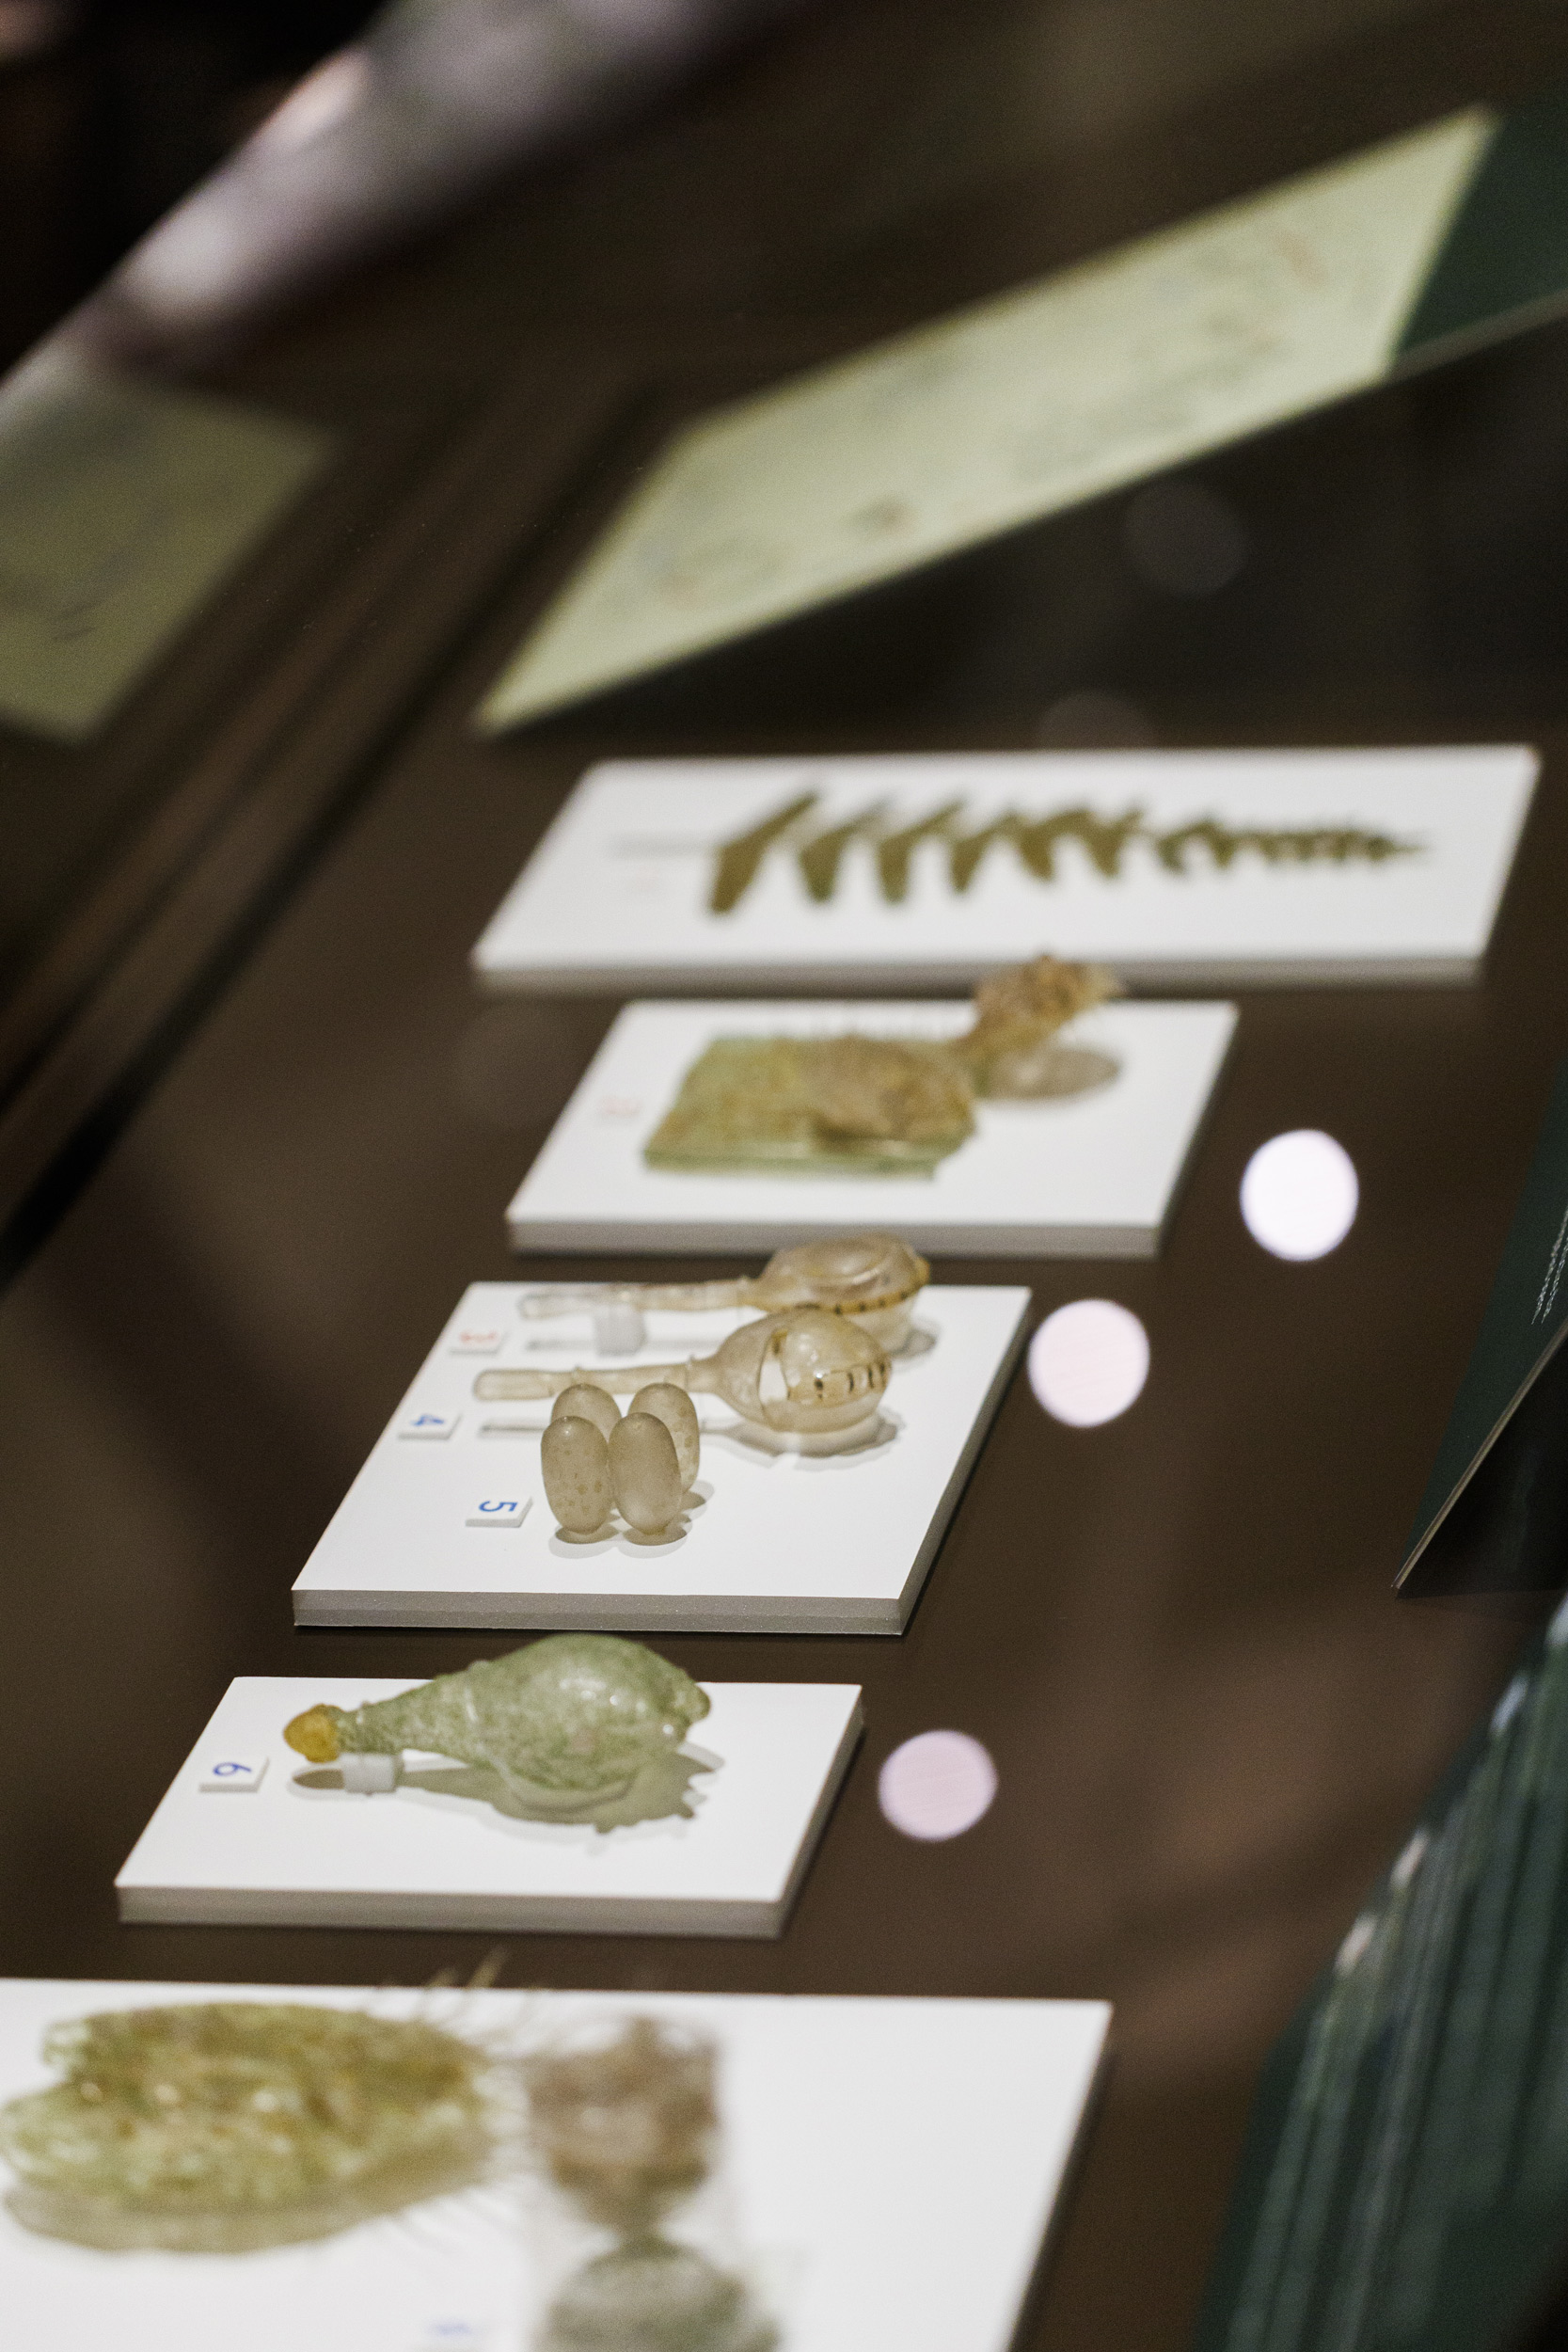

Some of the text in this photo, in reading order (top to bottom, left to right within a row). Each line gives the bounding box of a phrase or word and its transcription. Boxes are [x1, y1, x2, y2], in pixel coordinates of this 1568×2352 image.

[411, 1413, 445, 1427] 4
[478, 1500, 518, 1512] 5
[213, 1762, 252, 1776] 6
